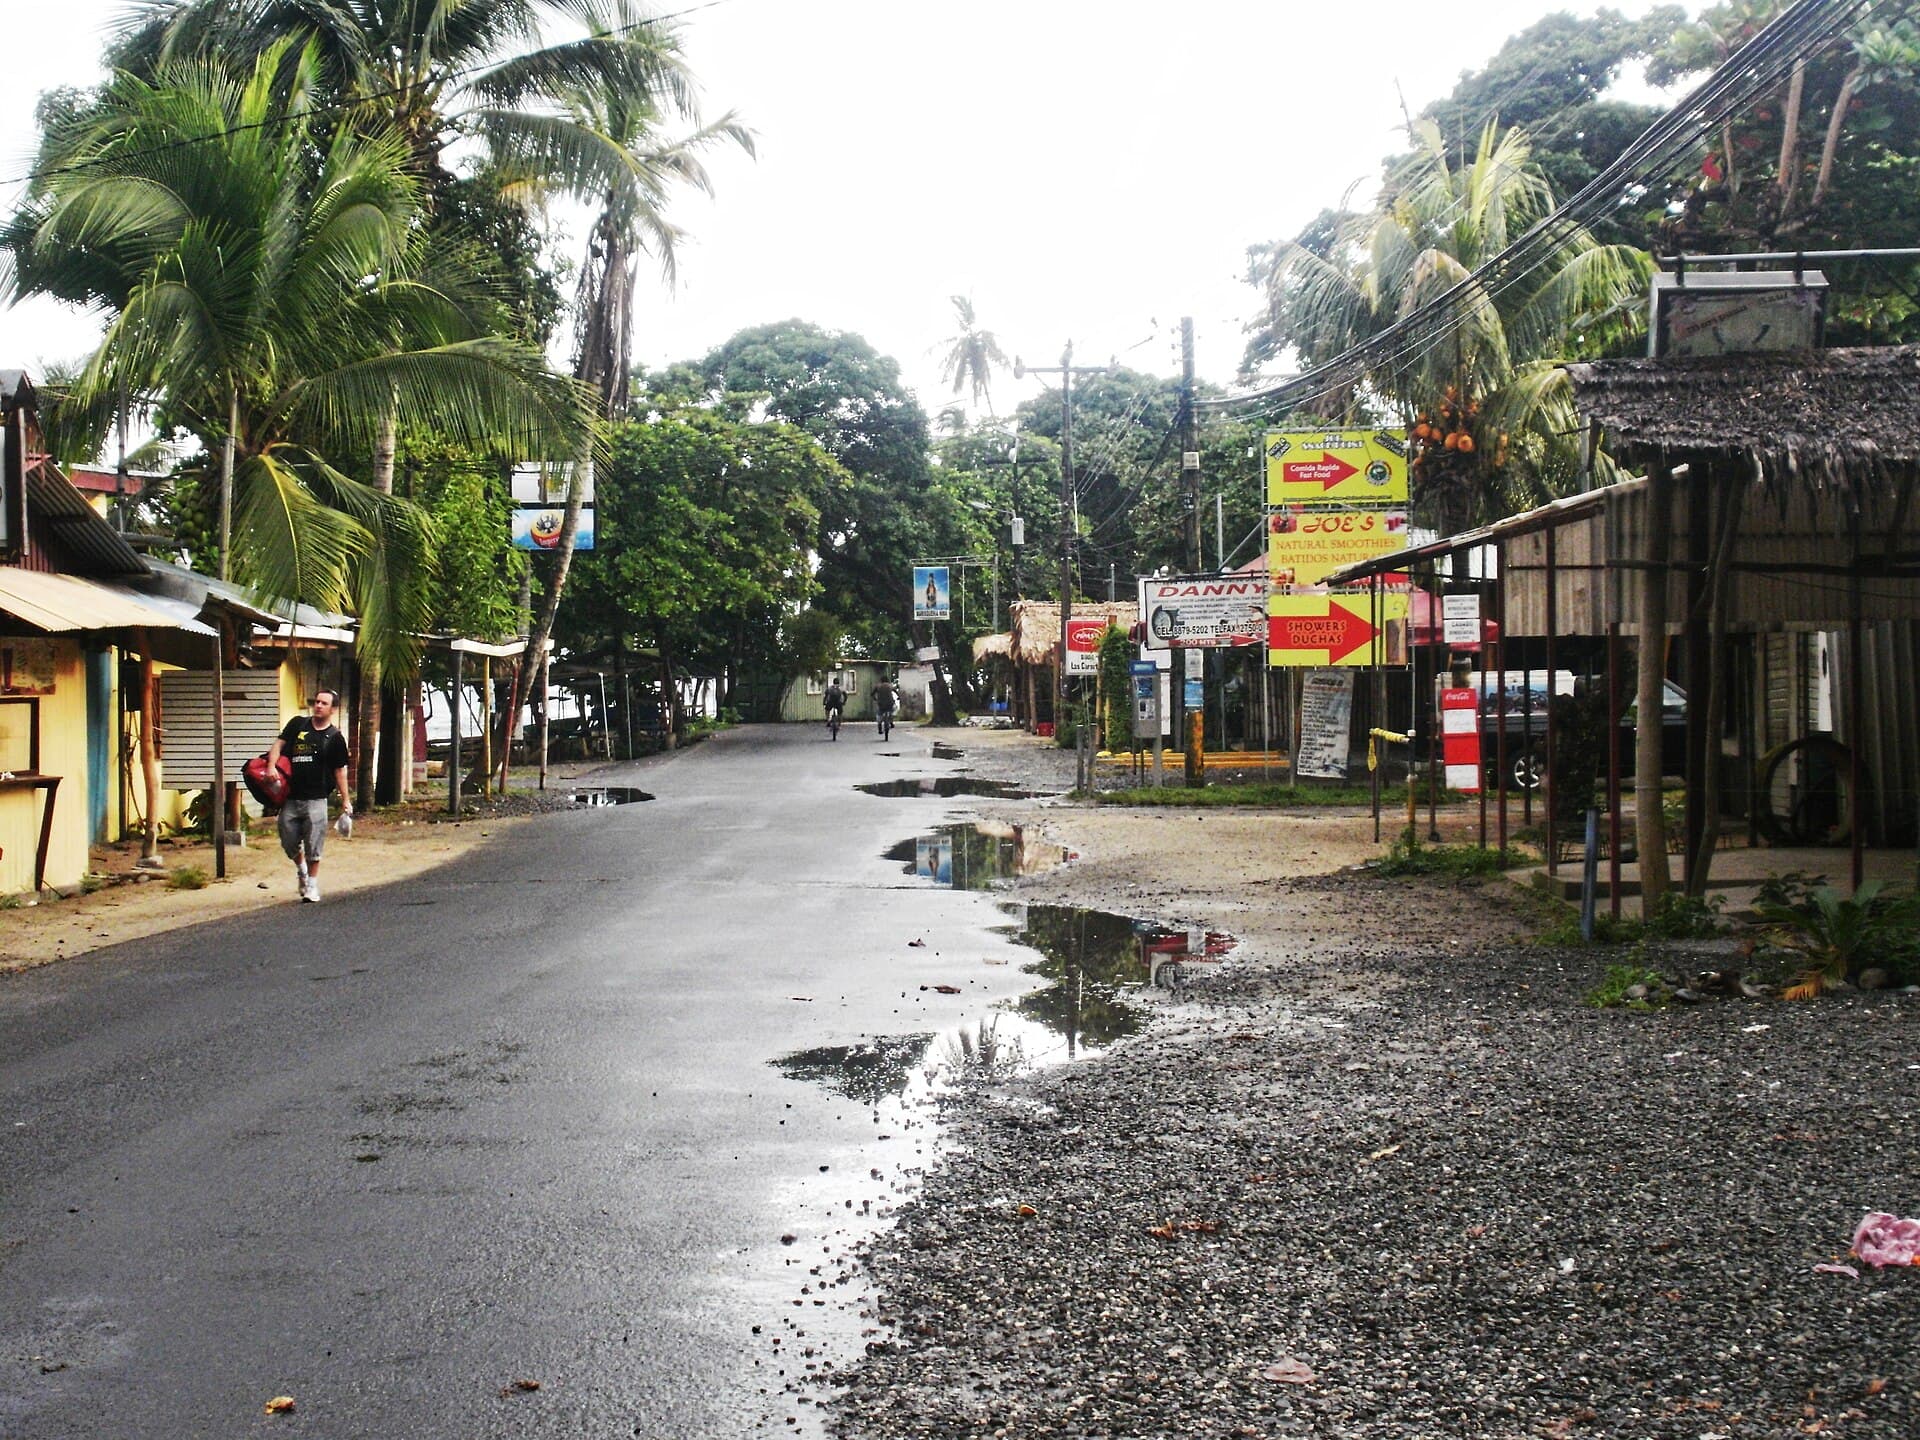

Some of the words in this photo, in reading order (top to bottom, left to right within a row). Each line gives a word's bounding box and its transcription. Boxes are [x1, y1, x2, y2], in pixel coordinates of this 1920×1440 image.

[1290, 464, 1316, 472] Comida
[1300, 471, 1312, 479] Fast
[1302, 515, 1375, 533] JOE'S
[1276, 540, 1328, 550] NATURAL
[1330, 538, 1397, 549] SMOOTHIES
[1281, 553, 1328, 564] BATIDOS
[1158, 583, 1264, 597] DANNY
[1288, 621, 1345, 632] SHOWERS
[1292, 634, 1343, 644] DUCHAS
